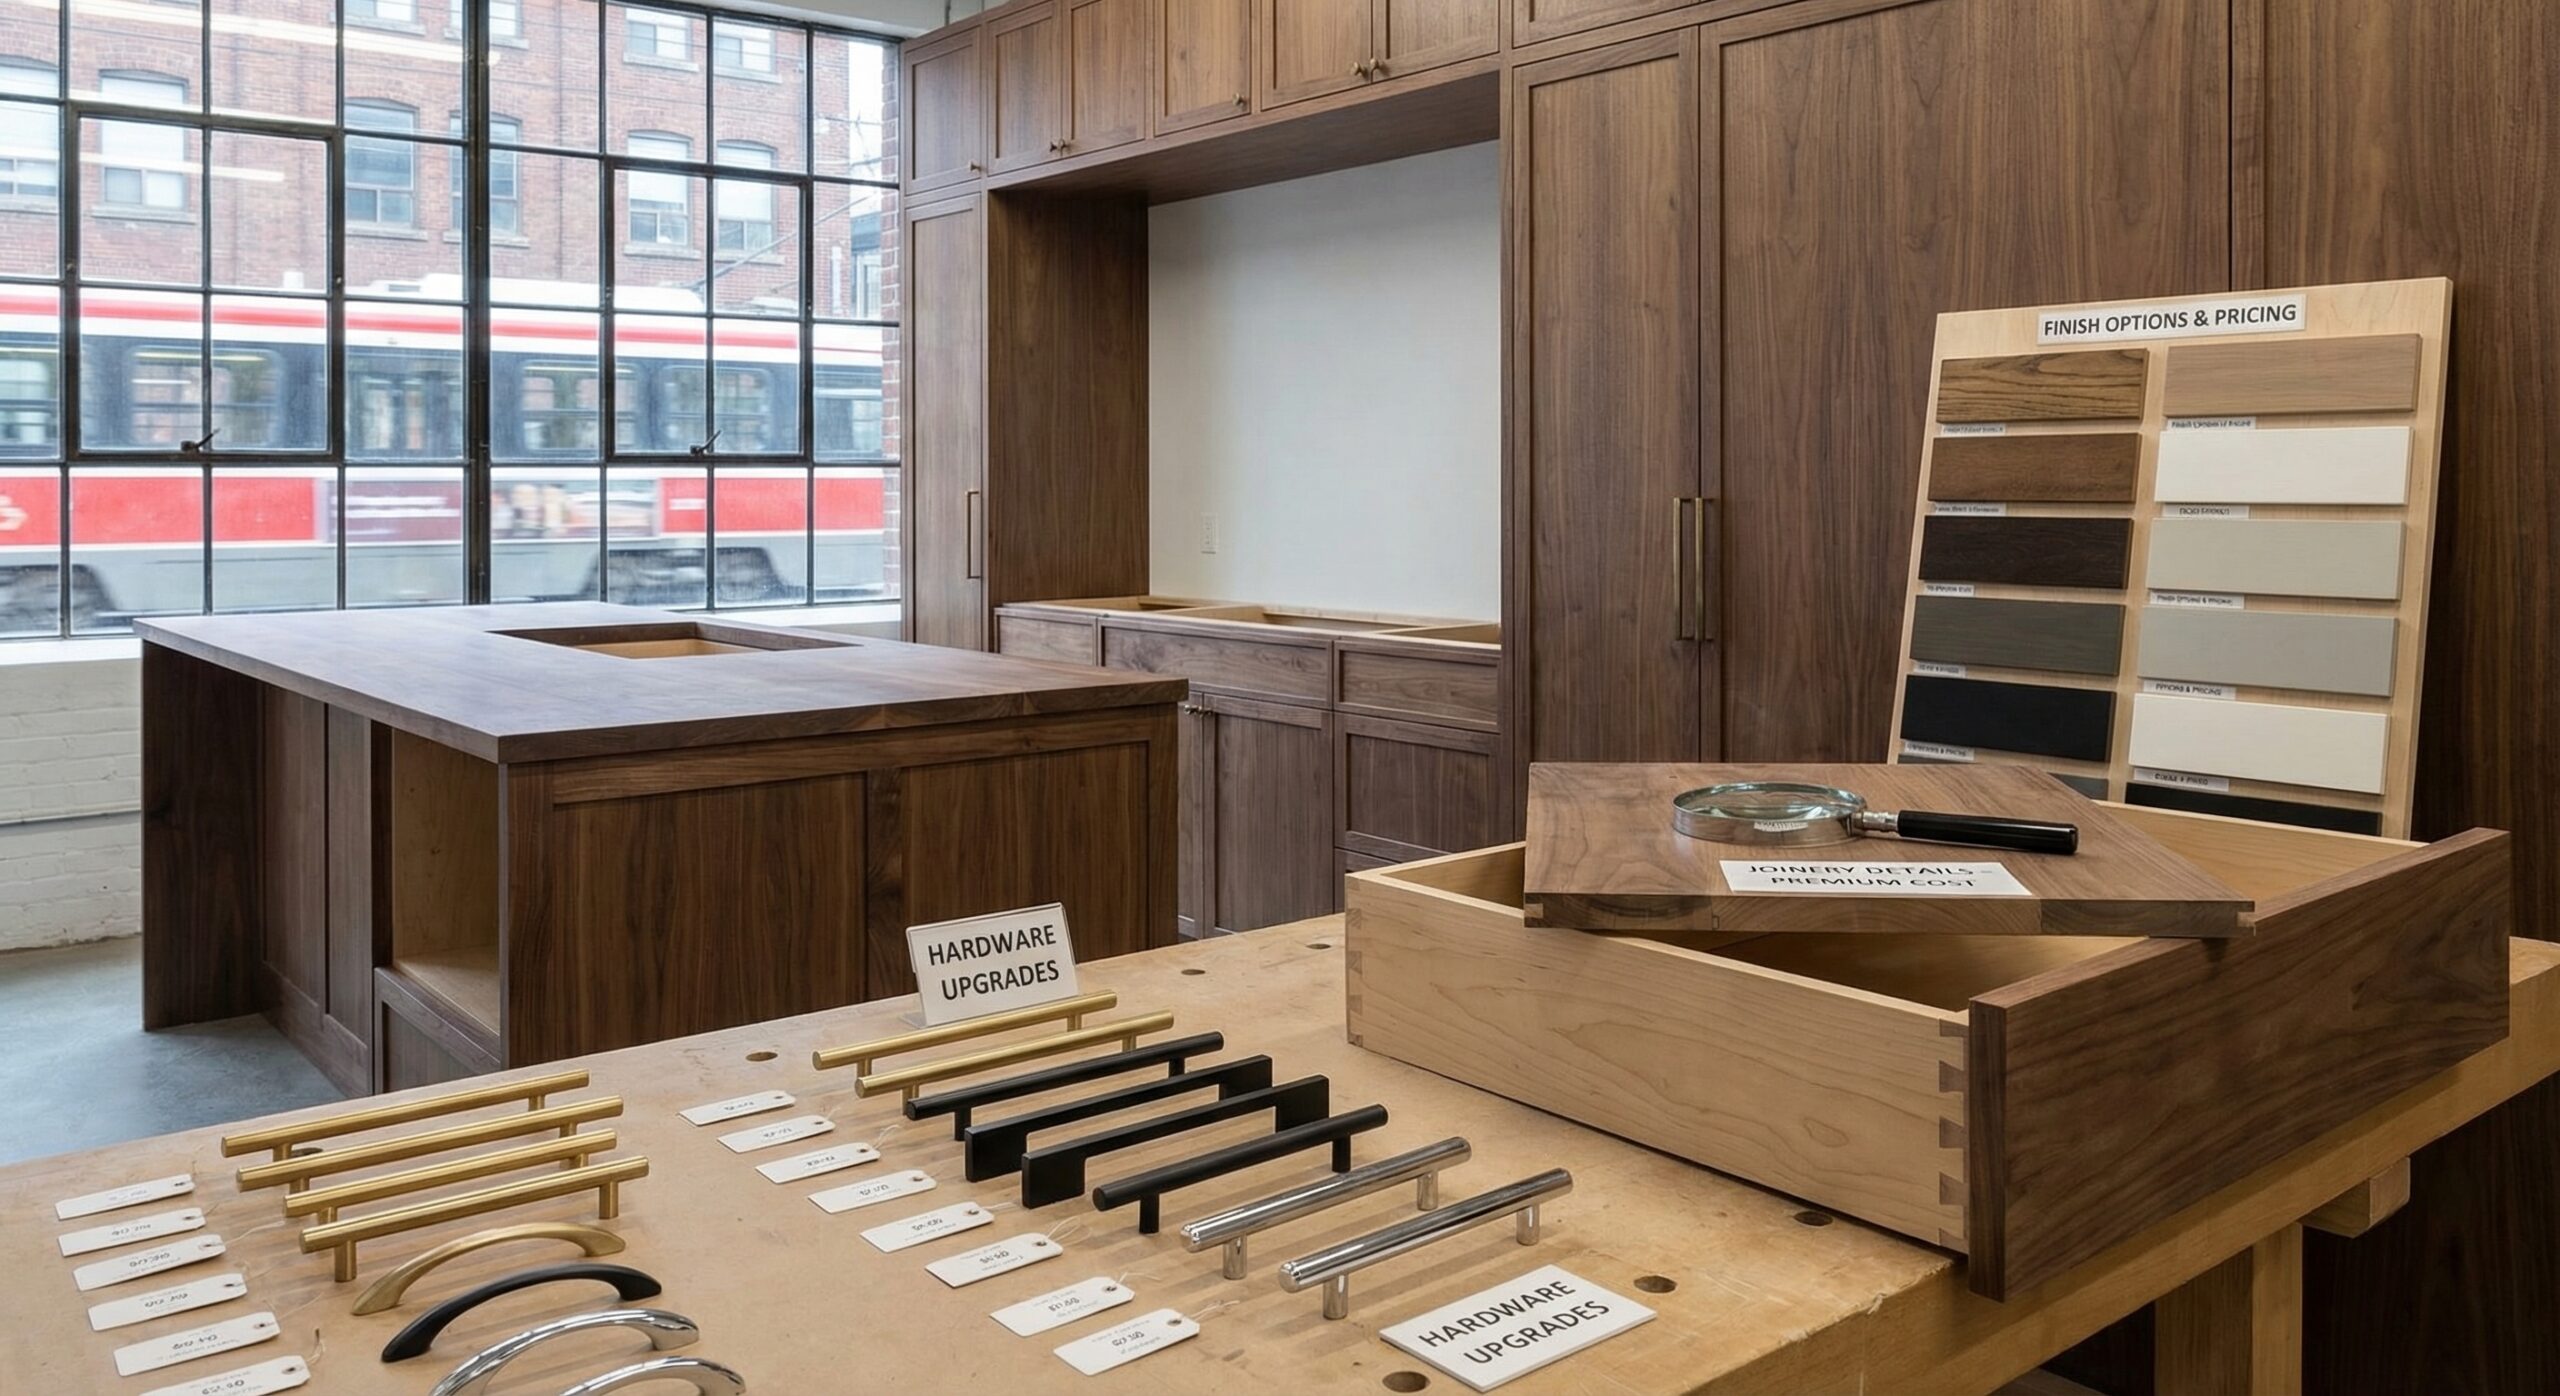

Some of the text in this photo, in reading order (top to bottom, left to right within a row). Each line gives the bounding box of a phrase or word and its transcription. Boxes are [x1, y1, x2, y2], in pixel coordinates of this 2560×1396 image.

[2044, 304, 2297, 336] FINISH OPTIONS & PRICING
[1749, 865, 1855, 875] JOINERY
[1865, 866, 1974, 876] DETAILS
[1771, 877, 1976, 888] PREMIUM COST
[928, 924, 1057, 966] HARDWARE
[941, 960, 1060, 1001] UPGRADES
[1417, 1280, 1576, 1347] HARDWARE
[1463, 1300, 1611, 1364] UPGRADES
